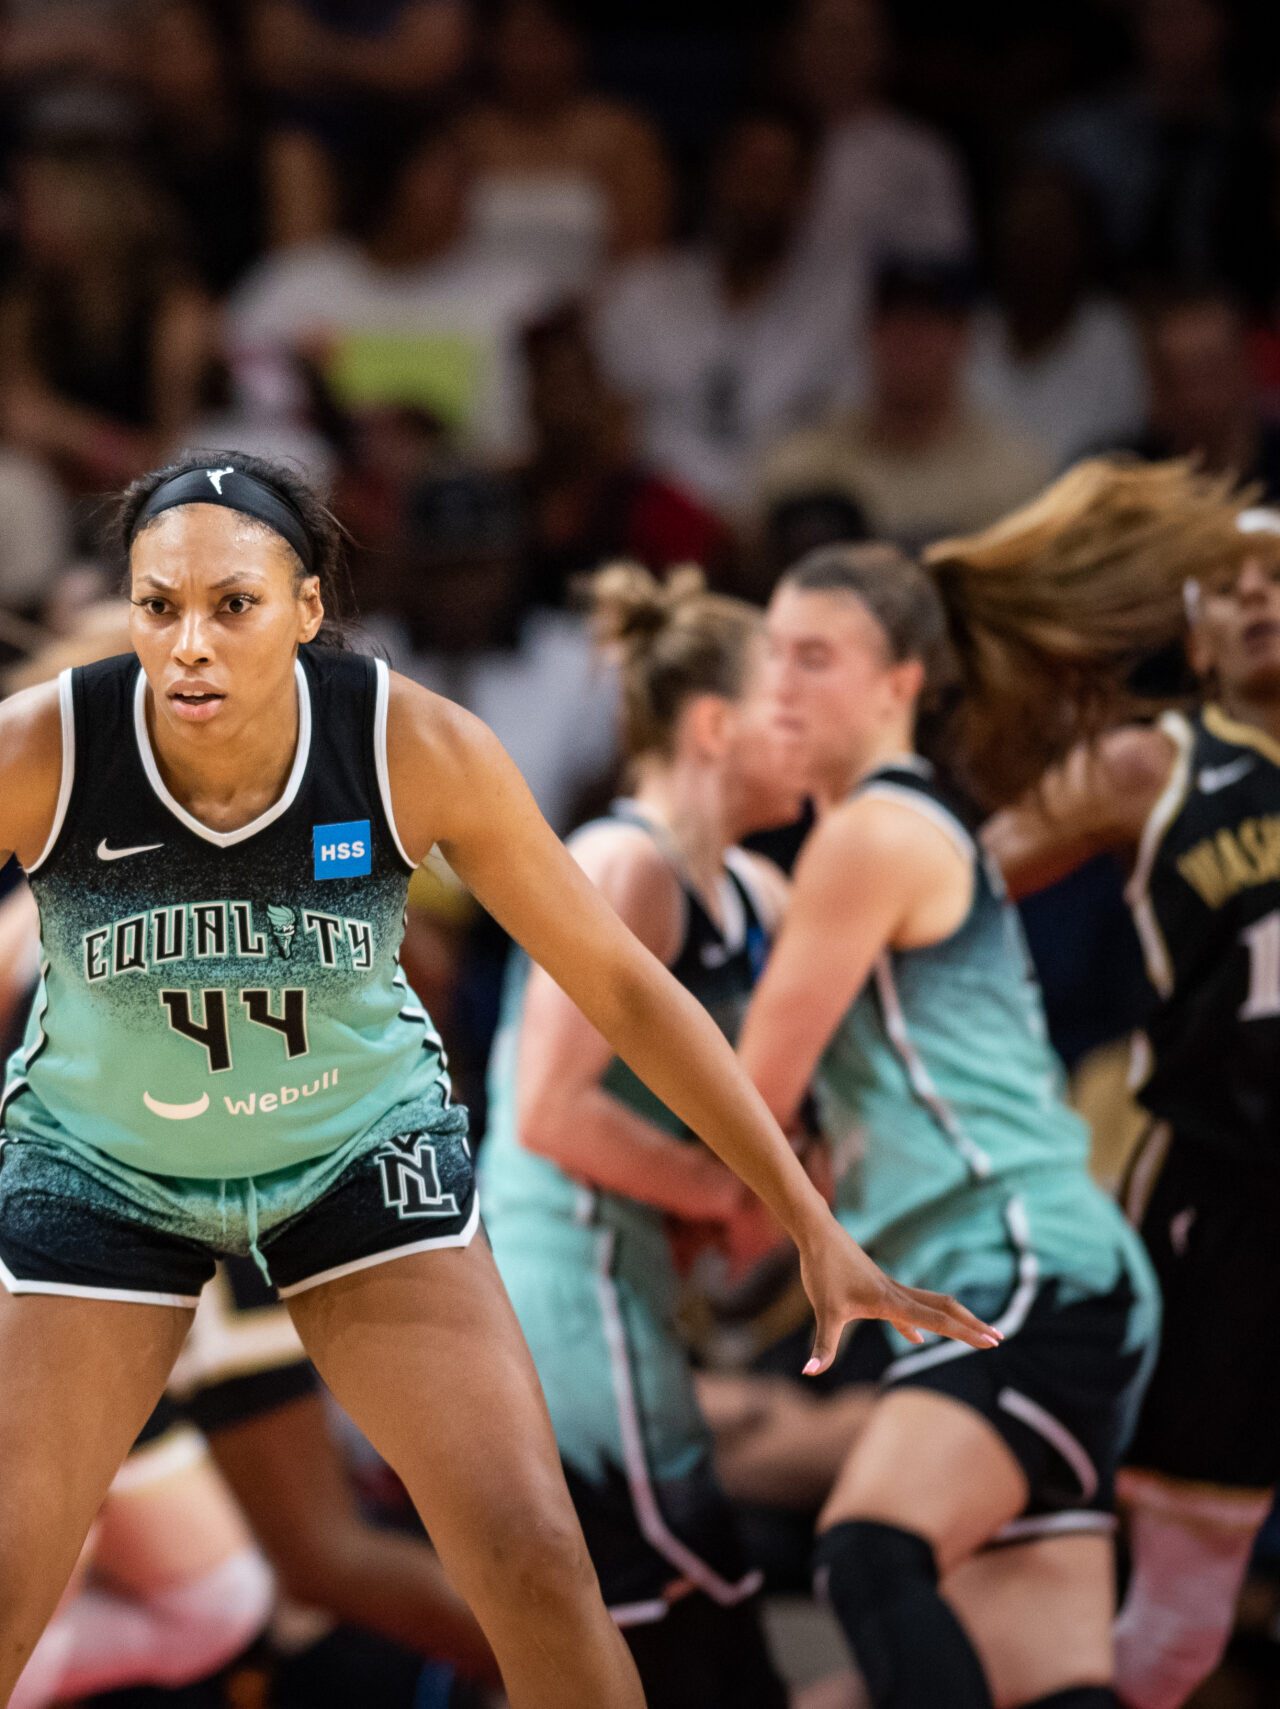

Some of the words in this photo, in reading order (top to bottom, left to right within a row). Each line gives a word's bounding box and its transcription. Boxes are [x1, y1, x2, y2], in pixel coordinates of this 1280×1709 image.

[320, 841, 366, 862] HSS
[160, 988, 310, 1074] 44
[224, 1068, 340, 1117] Webull
